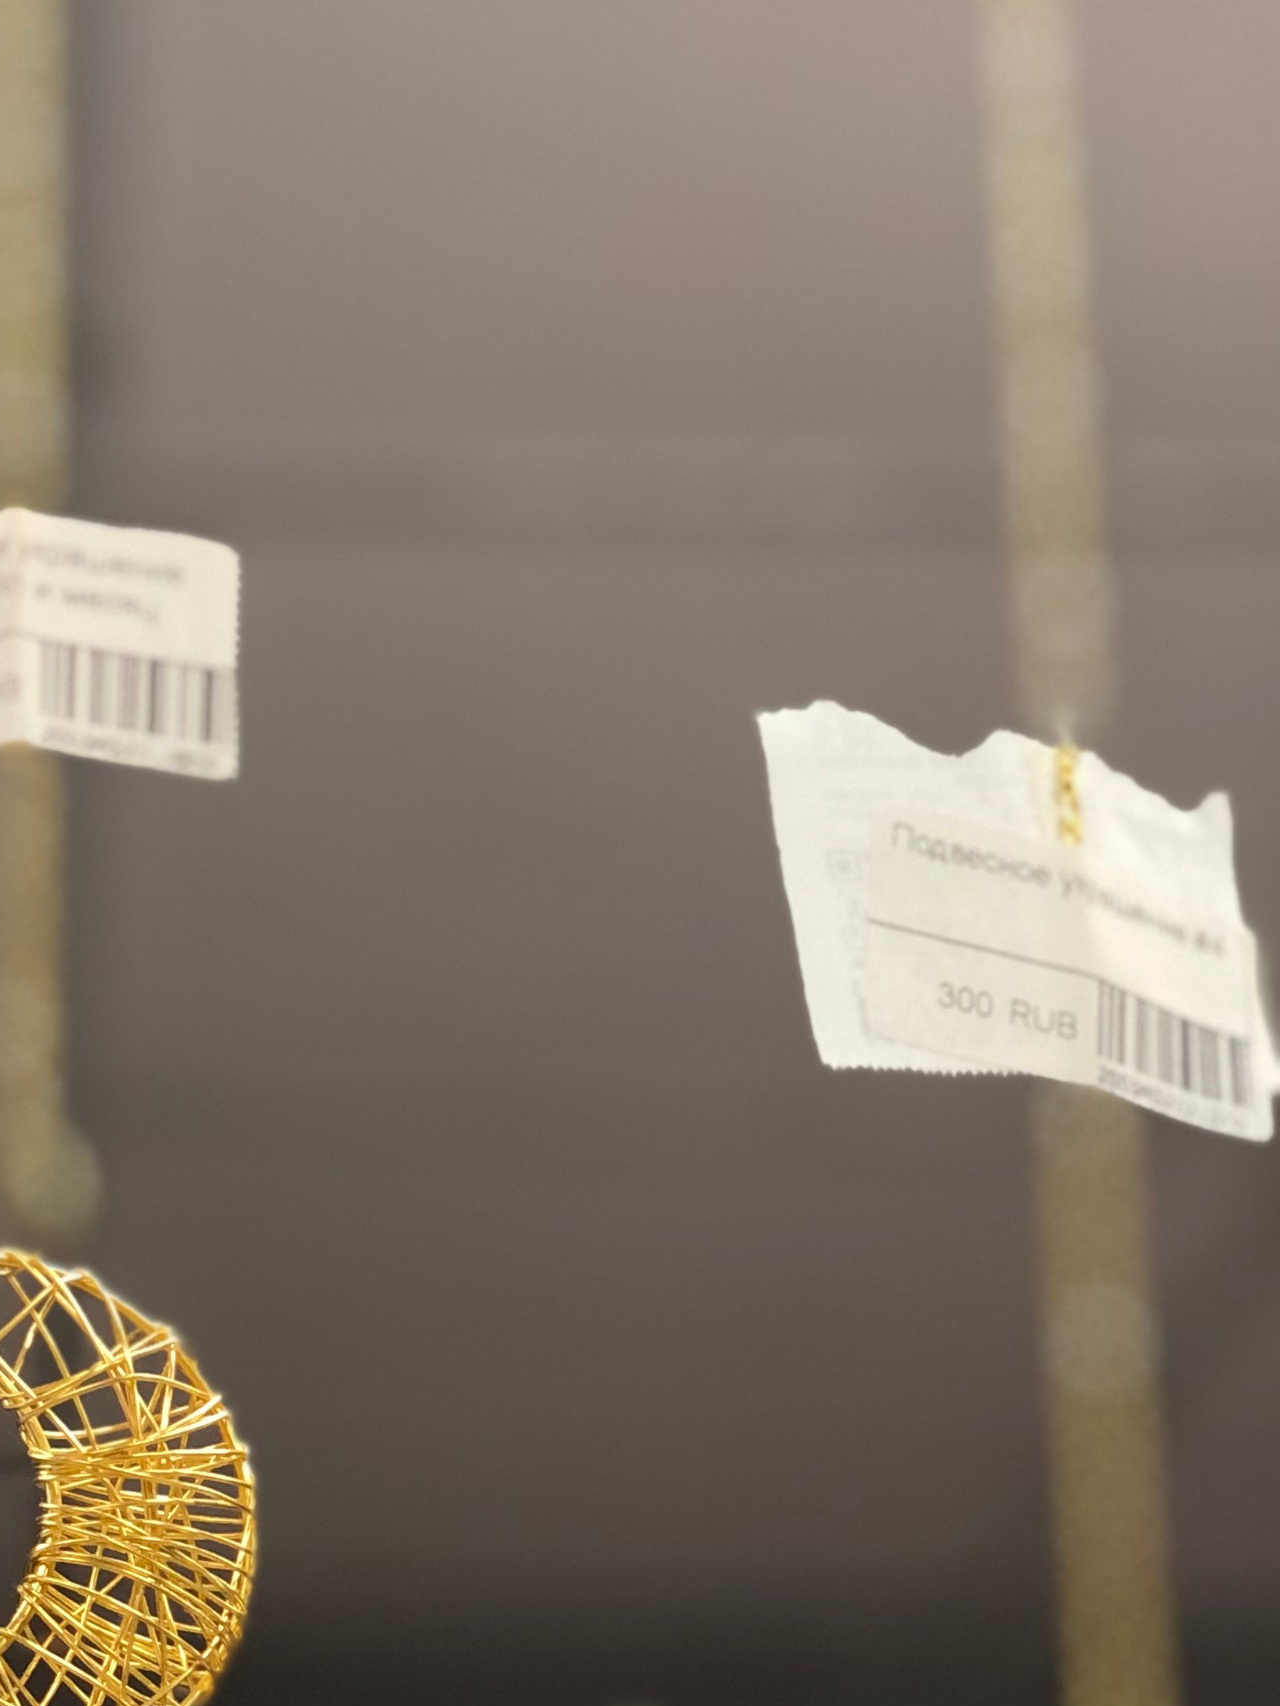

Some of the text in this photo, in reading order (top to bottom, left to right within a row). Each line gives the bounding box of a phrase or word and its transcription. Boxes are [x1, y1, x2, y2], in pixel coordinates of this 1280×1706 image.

[892, 821, 1052, 886] Подвесное
[938, 978, 1079, 1041] 300 RUB
